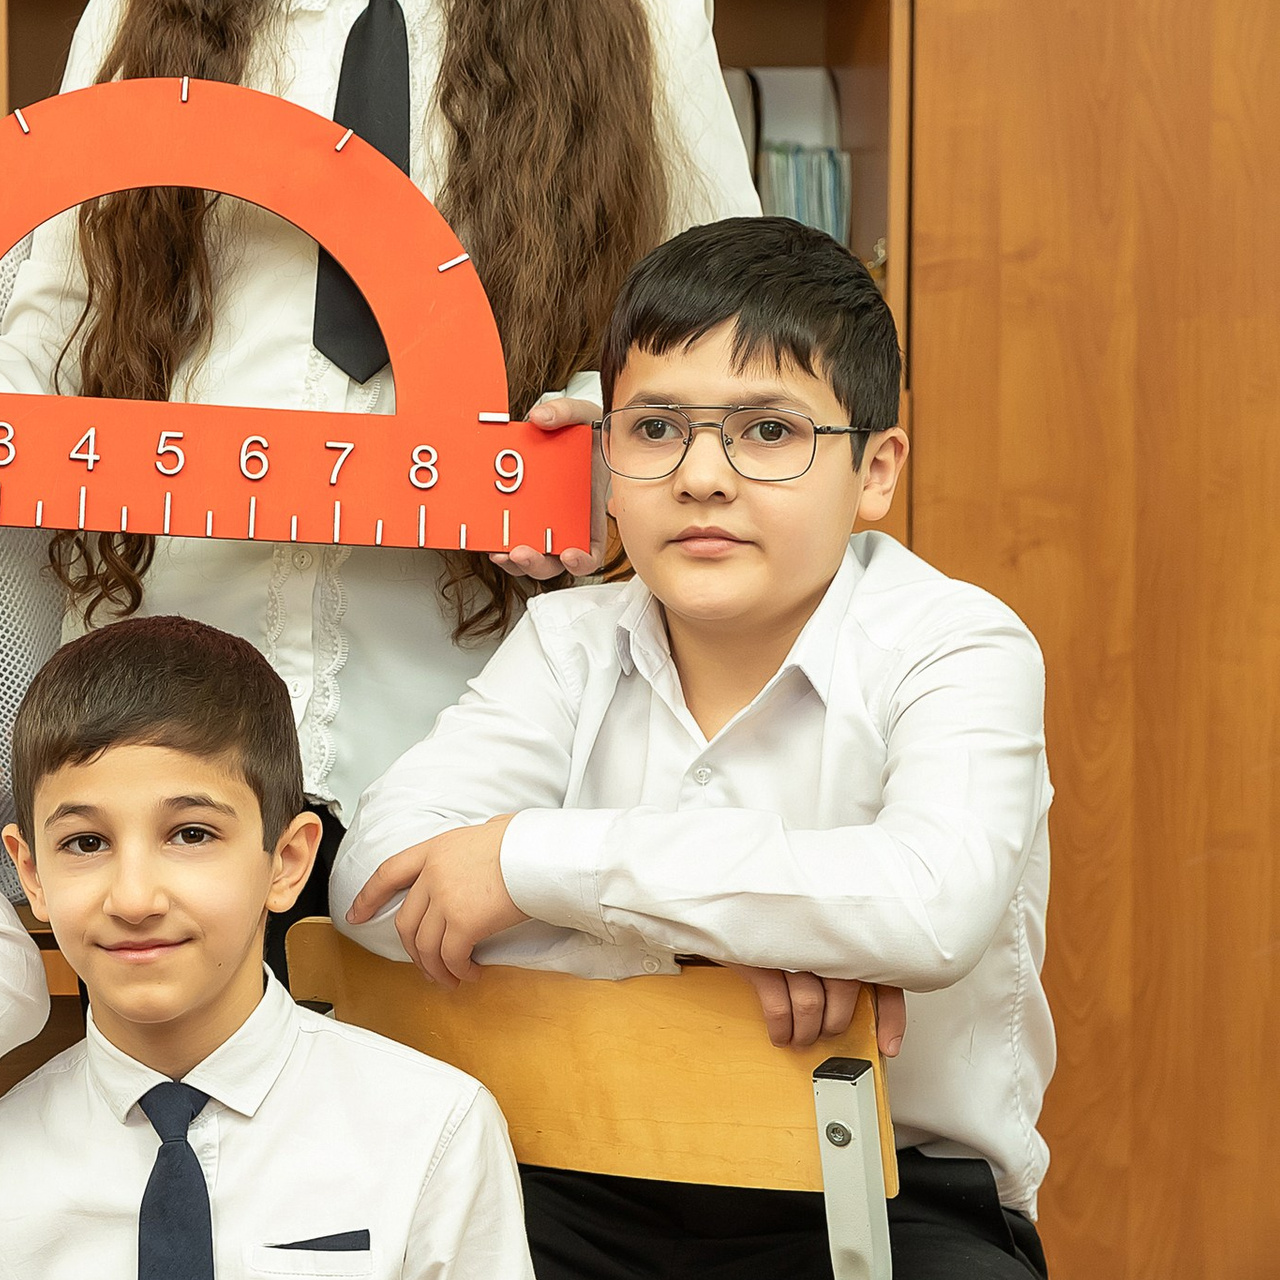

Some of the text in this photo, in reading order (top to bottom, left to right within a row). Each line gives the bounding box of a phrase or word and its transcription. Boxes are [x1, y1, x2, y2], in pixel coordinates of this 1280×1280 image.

[68, 426, 101, 471] 4
[154, 430, 186, 476] 5
[239, 435, 270, 481] 6
[324, 440, 356, 486] 7
[408, 444, 440, 490] 8
[494, 449, 525, 494] 9
